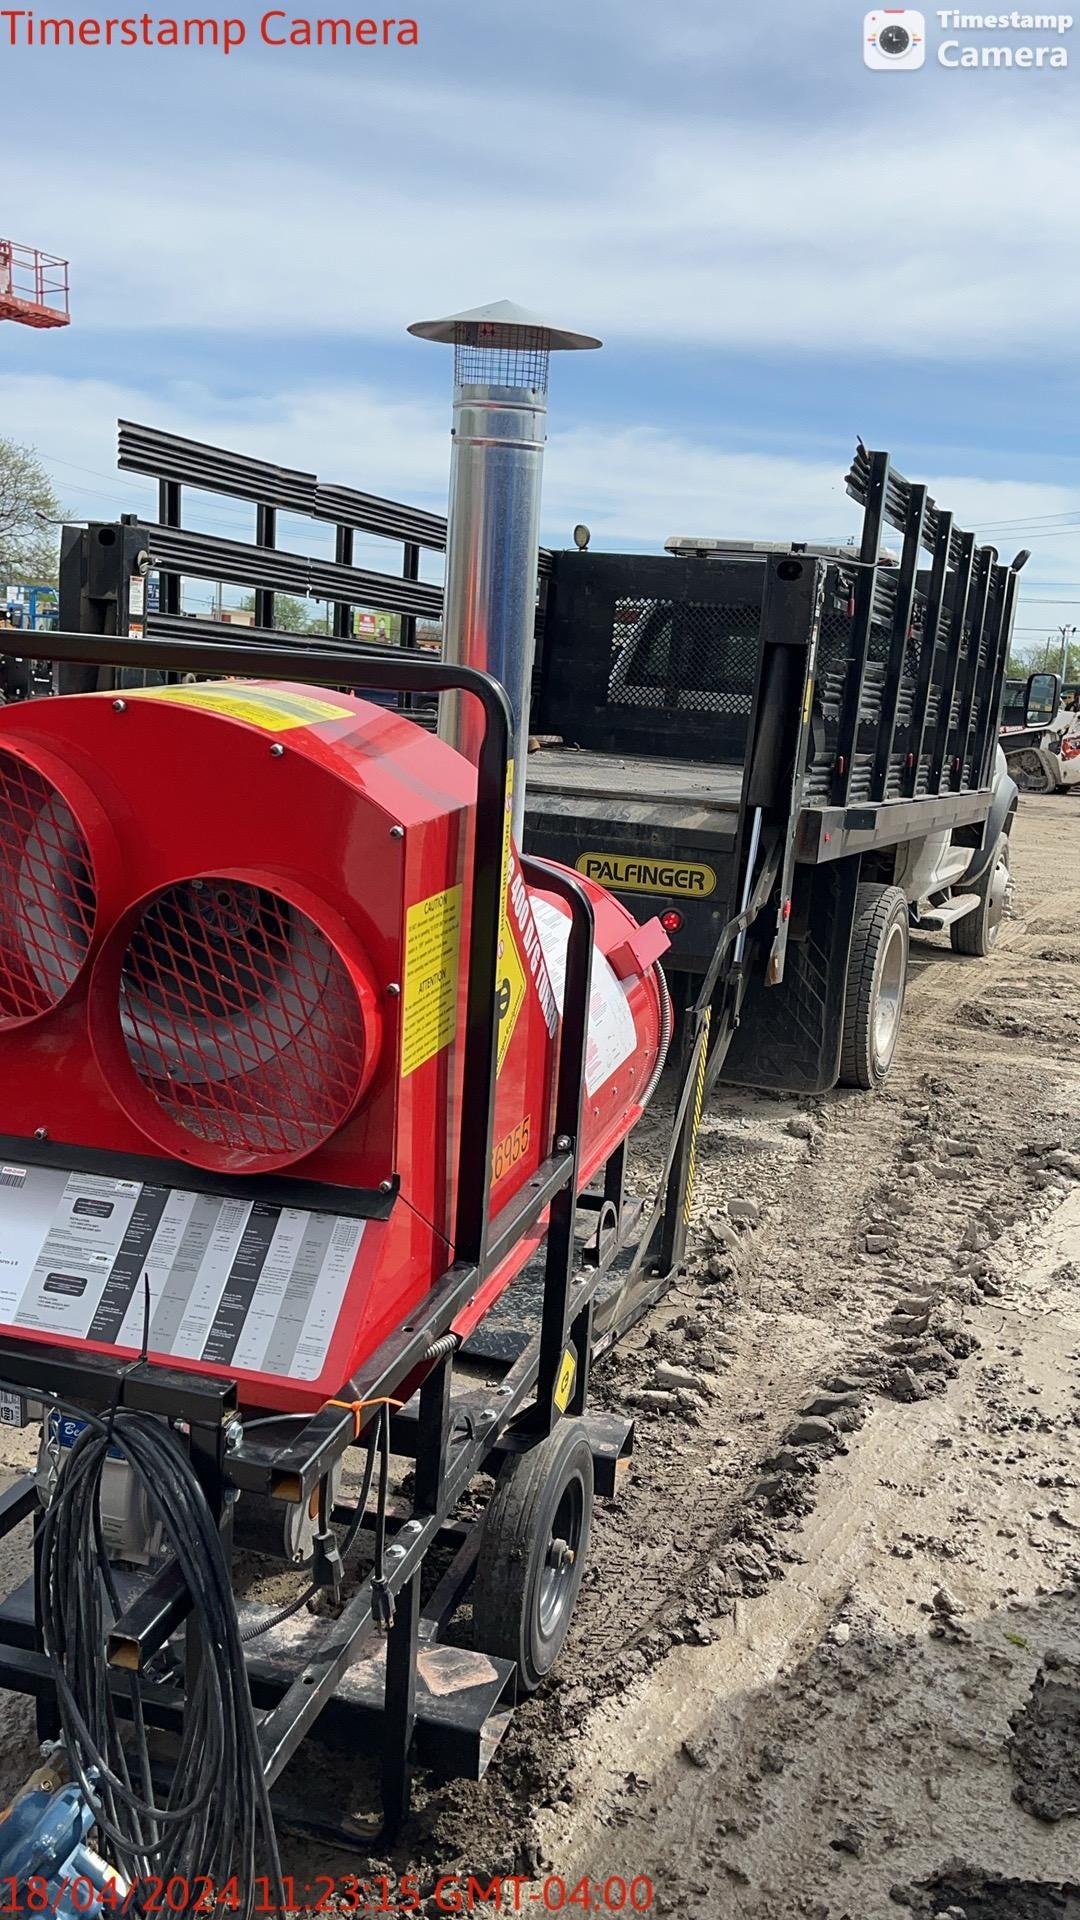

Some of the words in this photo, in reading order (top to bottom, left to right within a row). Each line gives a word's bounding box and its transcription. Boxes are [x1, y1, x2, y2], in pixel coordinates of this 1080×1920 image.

[586, 859, 706, 891] PALFINGER
[424, 895, 448, 914] CAUTION
[511, 872, 530, 932] 400
[523, 916, 542, 977] D/G
[535, 957, 559, 1040] TURBO
[418, 967, 447, 992] ATTENTION
[490, 1116, 530, 1180] 6955
